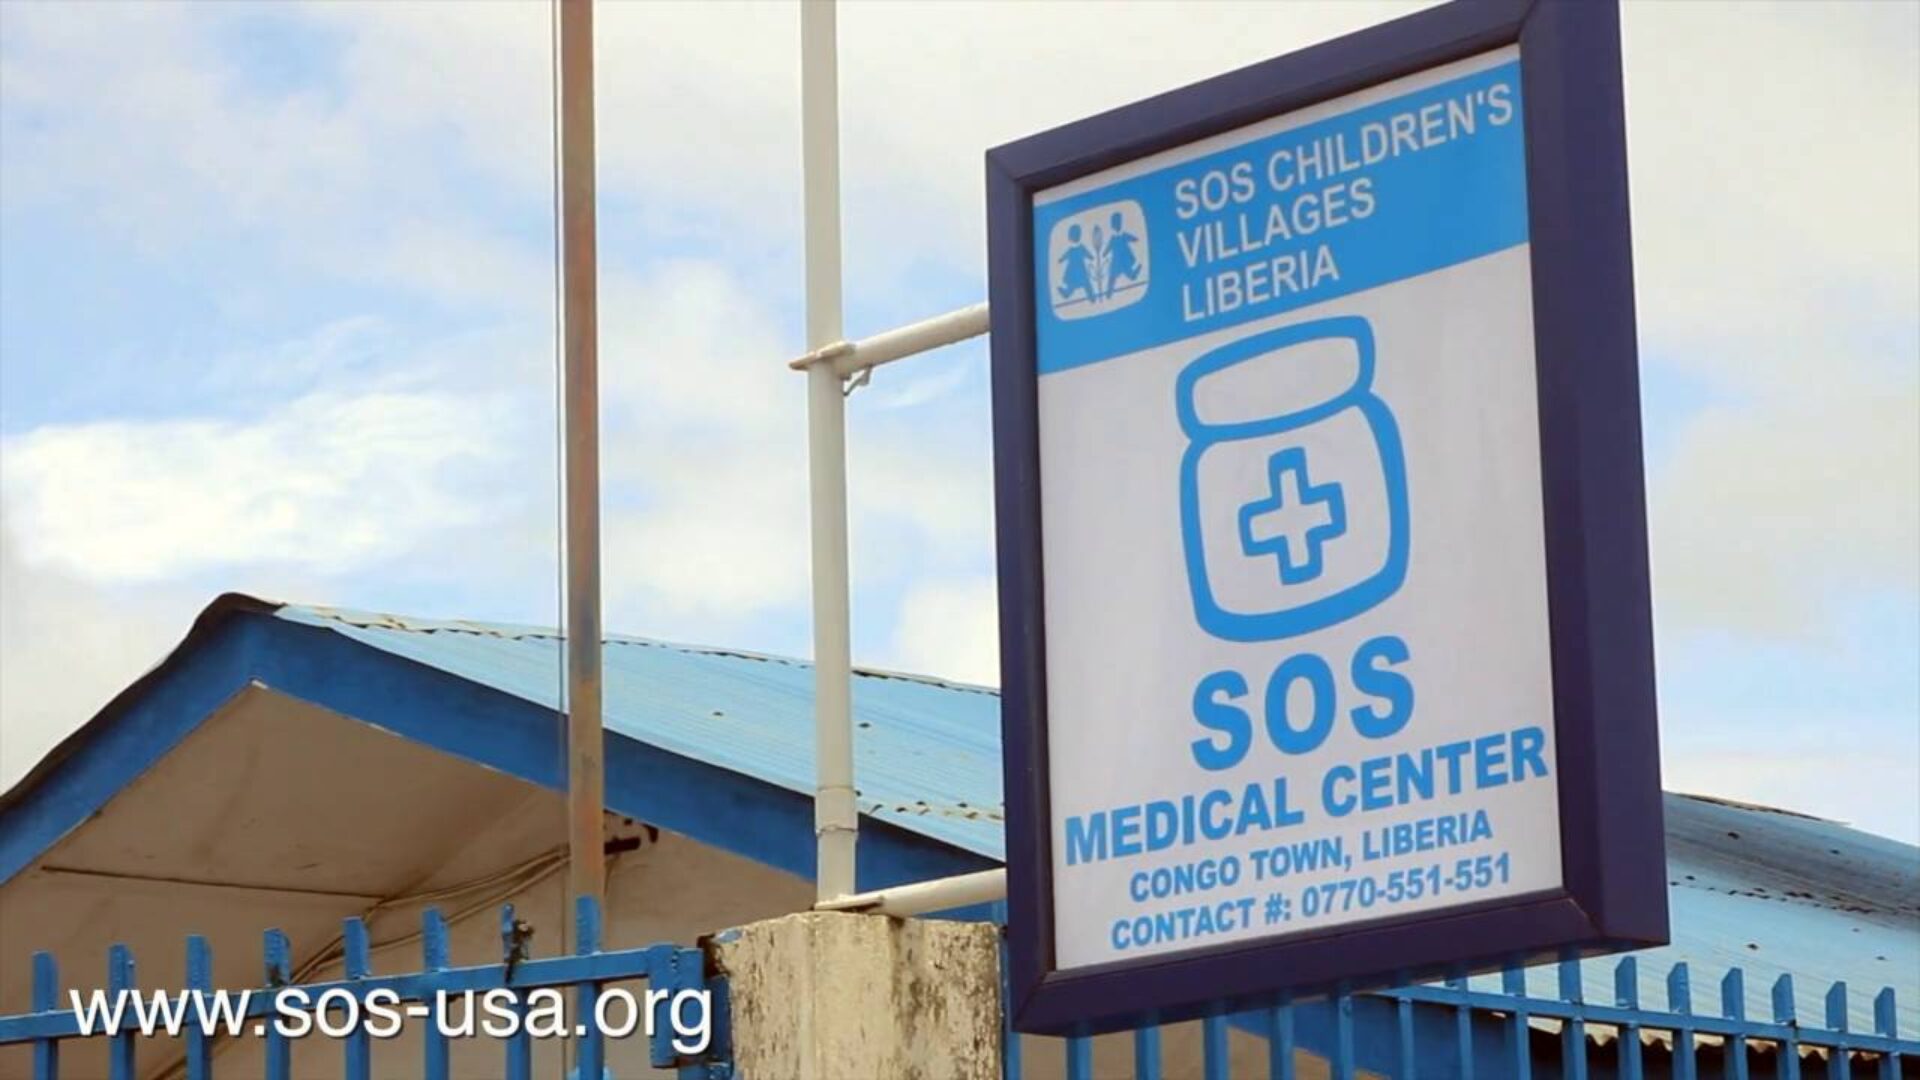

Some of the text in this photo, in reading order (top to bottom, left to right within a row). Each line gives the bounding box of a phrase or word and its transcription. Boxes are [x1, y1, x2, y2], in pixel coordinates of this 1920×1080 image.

[1174, 84, 1513, 220] SOS CHILDREN'S
[1177, 177, 1376, 268] VILLAGES
[1182, 244, 1339, 322] LIBERIA
[1191, 635, 1415, 771] SOS
[1065, 726, 1549, 866] MEDICAL CENTER
[1112, 852, 1511, 950] CONTACT #: 0770-551-551
[1130, 809, 1492, 902] CONGO TOWN, LIBERIA
